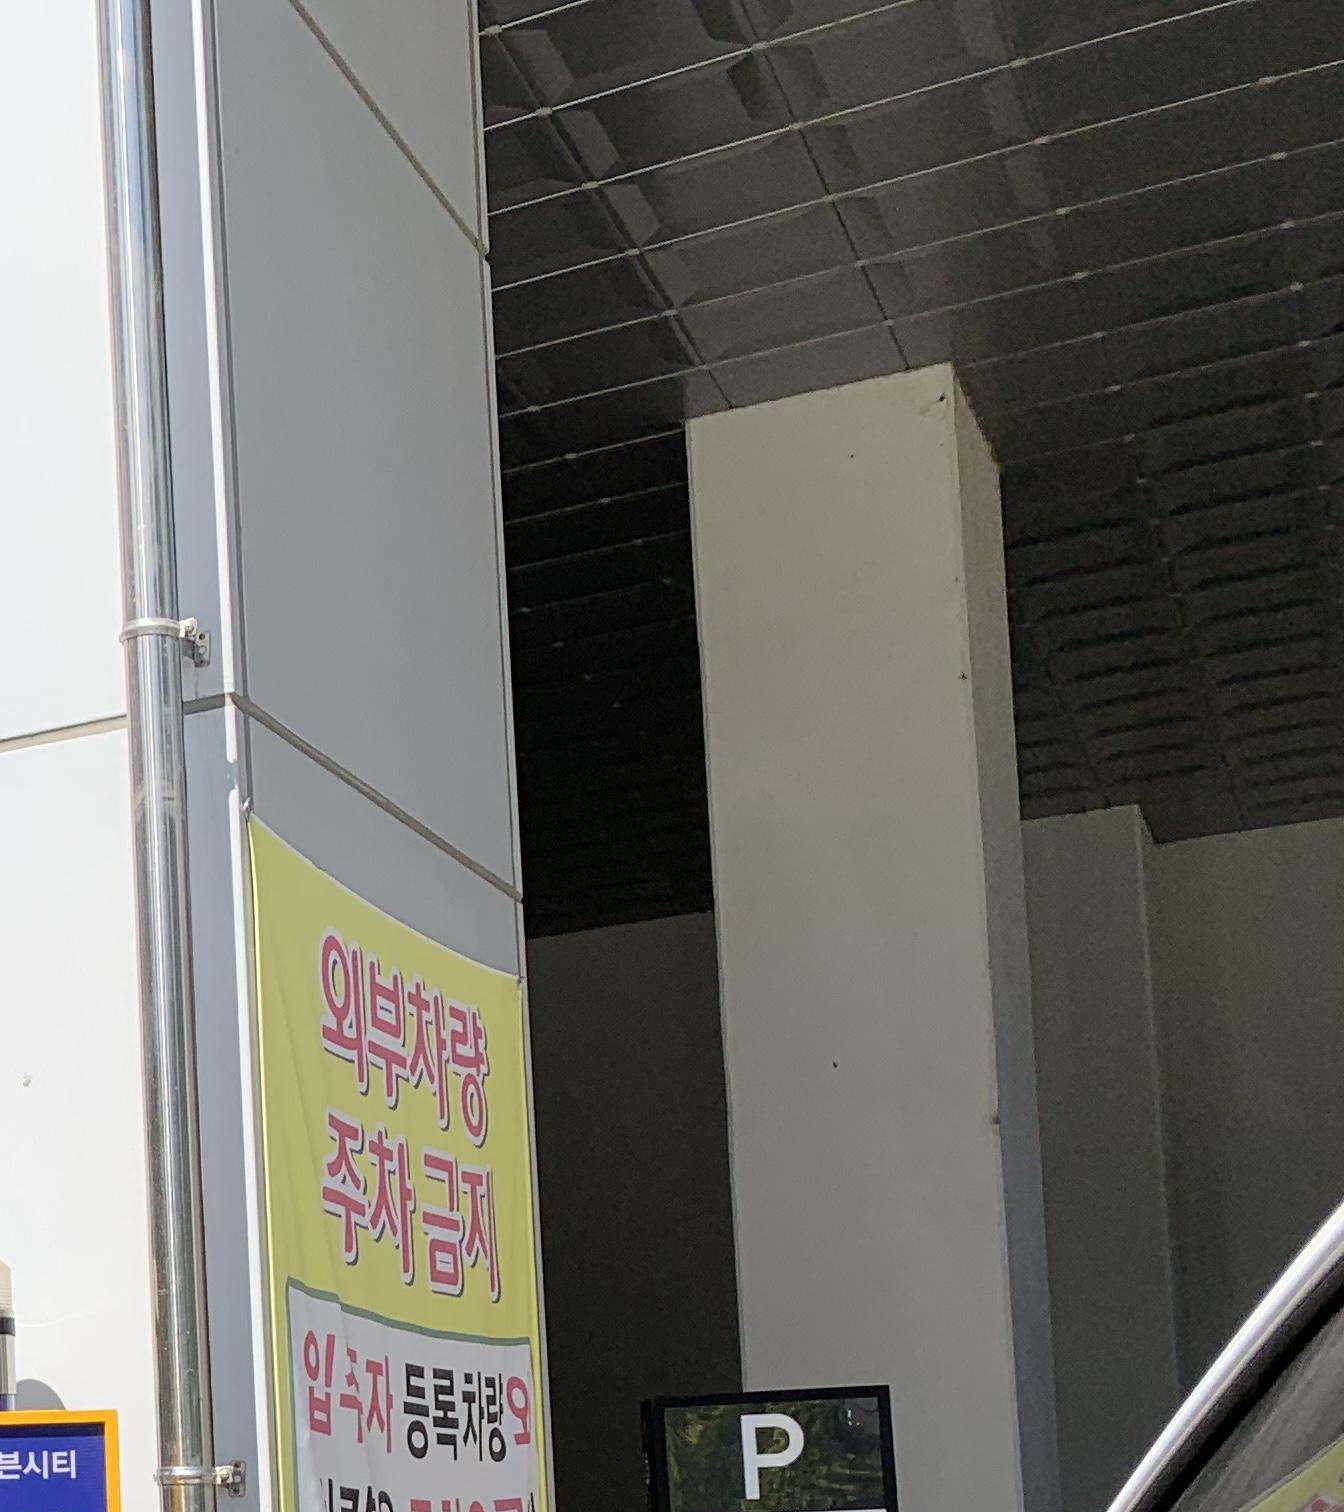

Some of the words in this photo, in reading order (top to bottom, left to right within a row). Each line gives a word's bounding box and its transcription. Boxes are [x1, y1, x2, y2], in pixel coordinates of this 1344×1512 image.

[320, 932, 488, 1142] 외부차량
[303, 1330, 394, 1454] 입주자
[740, 1412, 805, 1500] P
